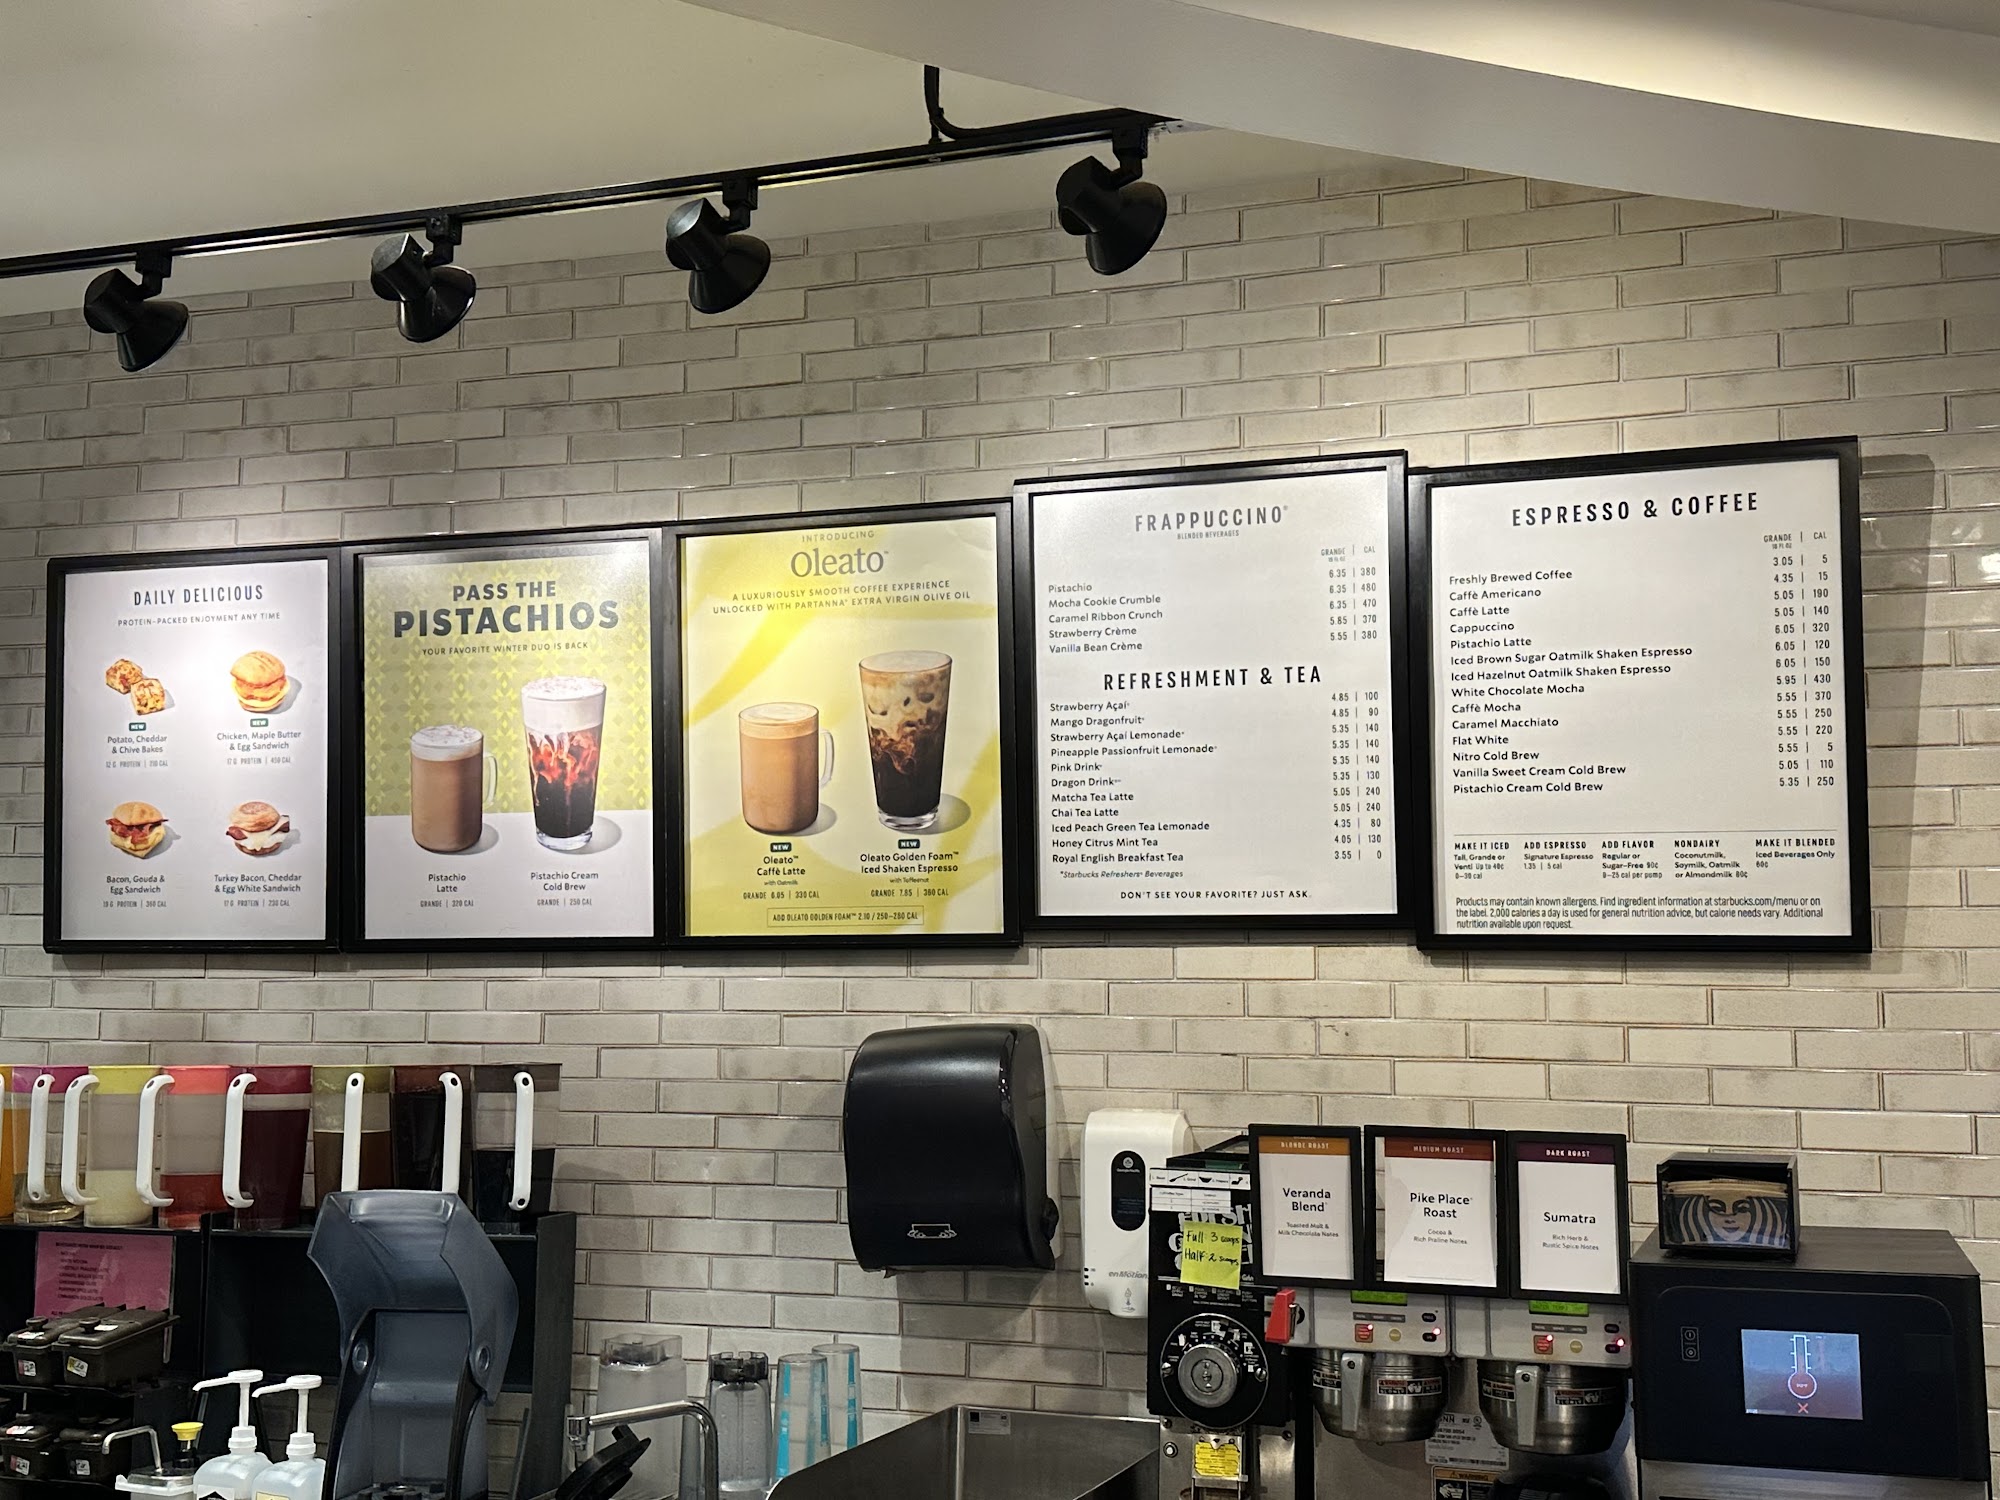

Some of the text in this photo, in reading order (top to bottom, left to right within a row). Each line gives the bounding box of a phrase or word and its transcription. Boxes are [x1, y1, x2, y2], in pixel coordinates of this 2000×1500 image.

[1512, 492, 1756, 526] ESPRESSO & COFFEE
[802, 530, 874, 542] INTRODUCING
[1449, 569, 1572, 585] Freshly Brewed Coffee
[1773, 571, 1828, 582] 4.35 15
[453, 580, 555, 601] PASS THE
[741, 589, 805, 600] LUXURIOUSLY
[809, 586, 849, 596] SMOOTH
[853, 584, 887, 593] COFFEE
[892, 579, 949, 591] EXPERIENCE
[1048, 582, 1092, 593] Pistachio
[1329, 582, 1376, 593] 6.35 480
[134, 584, 262, 605] DAILY DELICIOUS
[1449, 589, 1541, 601] Caffè Americano
[712, 604, 762, 614] UNLOCKED
[851, 596, 882, 605] EXTRA
[885, 594, 919, 603] VIRGIN
[923, 591, 950, 601] OLIVE
[954, 591, 970, 599] OIL
[1048, 594, 1160, 607] Mocha Cookie Crumble
[190, 614, 238, 623] ENJOYMENT
[394, 600, 618, 638] PISTACHIOS
[1048, 609, 1162, 623] Caramel Ribbon Crunch
[1330, 614, 1376, 625] 5.85 370
[1049, 626, 1136, 638] Strawberry Crème
[1450, 623, 1514, 634] Cappuccino
[1049, 641, 1142, 653] Vanilla Bean Crème
[1450, 638, 1531, 648] Pistachio Latte
[422, 647, 445, 655] YOUR
[448, 645, 489, 654] FAVORITE
[493, 644, 527, 652] WINTER
[1104, 665, 1320, 690] REFRESHMENT & TEA
[1776, 673, 1830, 684] 5.95 430
[1452, 717, 1558, 729] Caramel Macchiato
[135, 734, 167, 742] Cheddar
[251, 731, 275, 740] Maple
[1452, 735, 1508, 745] Flat White
[111, 746, 117, 754] &
[237, 742, 250, 752] Egg
[252, 741, 289, 749] Sandwich
[1052, 837, 1157, 849] Honey Citrus Mint Tea
[1544, 841, 1586, 849] ESPRESSO
[1601, 840, 1653, 848] ADD FLAVOR
[1674, 839, 1719, 847] NONDAIRY
[1755, 838, 1834, 846] MAKE IT BLENDED
[860, 853, 890, 862] Oleato
[892, 852, 925, 861] Golden
[756, 867, 805, 875] Caffè Latte
[861, 864, 958, 874] Iced Shaken Espresso
[159, 874, 164, 882] &
[214, 874, 238, 883] Turkey
[268, 873, 301, 881] Cheddar
[428, 873, 466, 881] Pistachio
[530, 871, 598, 880] Pistachio Cream
[110, 885, 160, 895] Egg Sandwich
[214, 884, 220, 892] &
[222, 884, 235, 894] Egg
[262, 884, 300, 892] Sandwich
[543, 882, 585, 890] Cold Brew
[1121, 890, 1151, 899] DON'T
[1154, 890, 1171, 899] SEE
[1174, 890, 1202, 899] YOUR
[1205, 890, 1258, 899] FAVORITE?
[1261, 890, 1286, 899] JUST
[1456, 919, 1488, 928] nutrition
[1489, 919, 1521, 928] available
[1522, 920, 1541, 930] upon
[1282, 1187, 1330, 1201] Veranda
[1410, 1192, 1434, 1203] Pike
[1423, 1207, 1456, 1218] Roast
[1543, 1211, 1595, 1223] Sumatra
[1211, 1231, 1218, 1242] 3
[1208, 1253, 1217, 1262] 2
